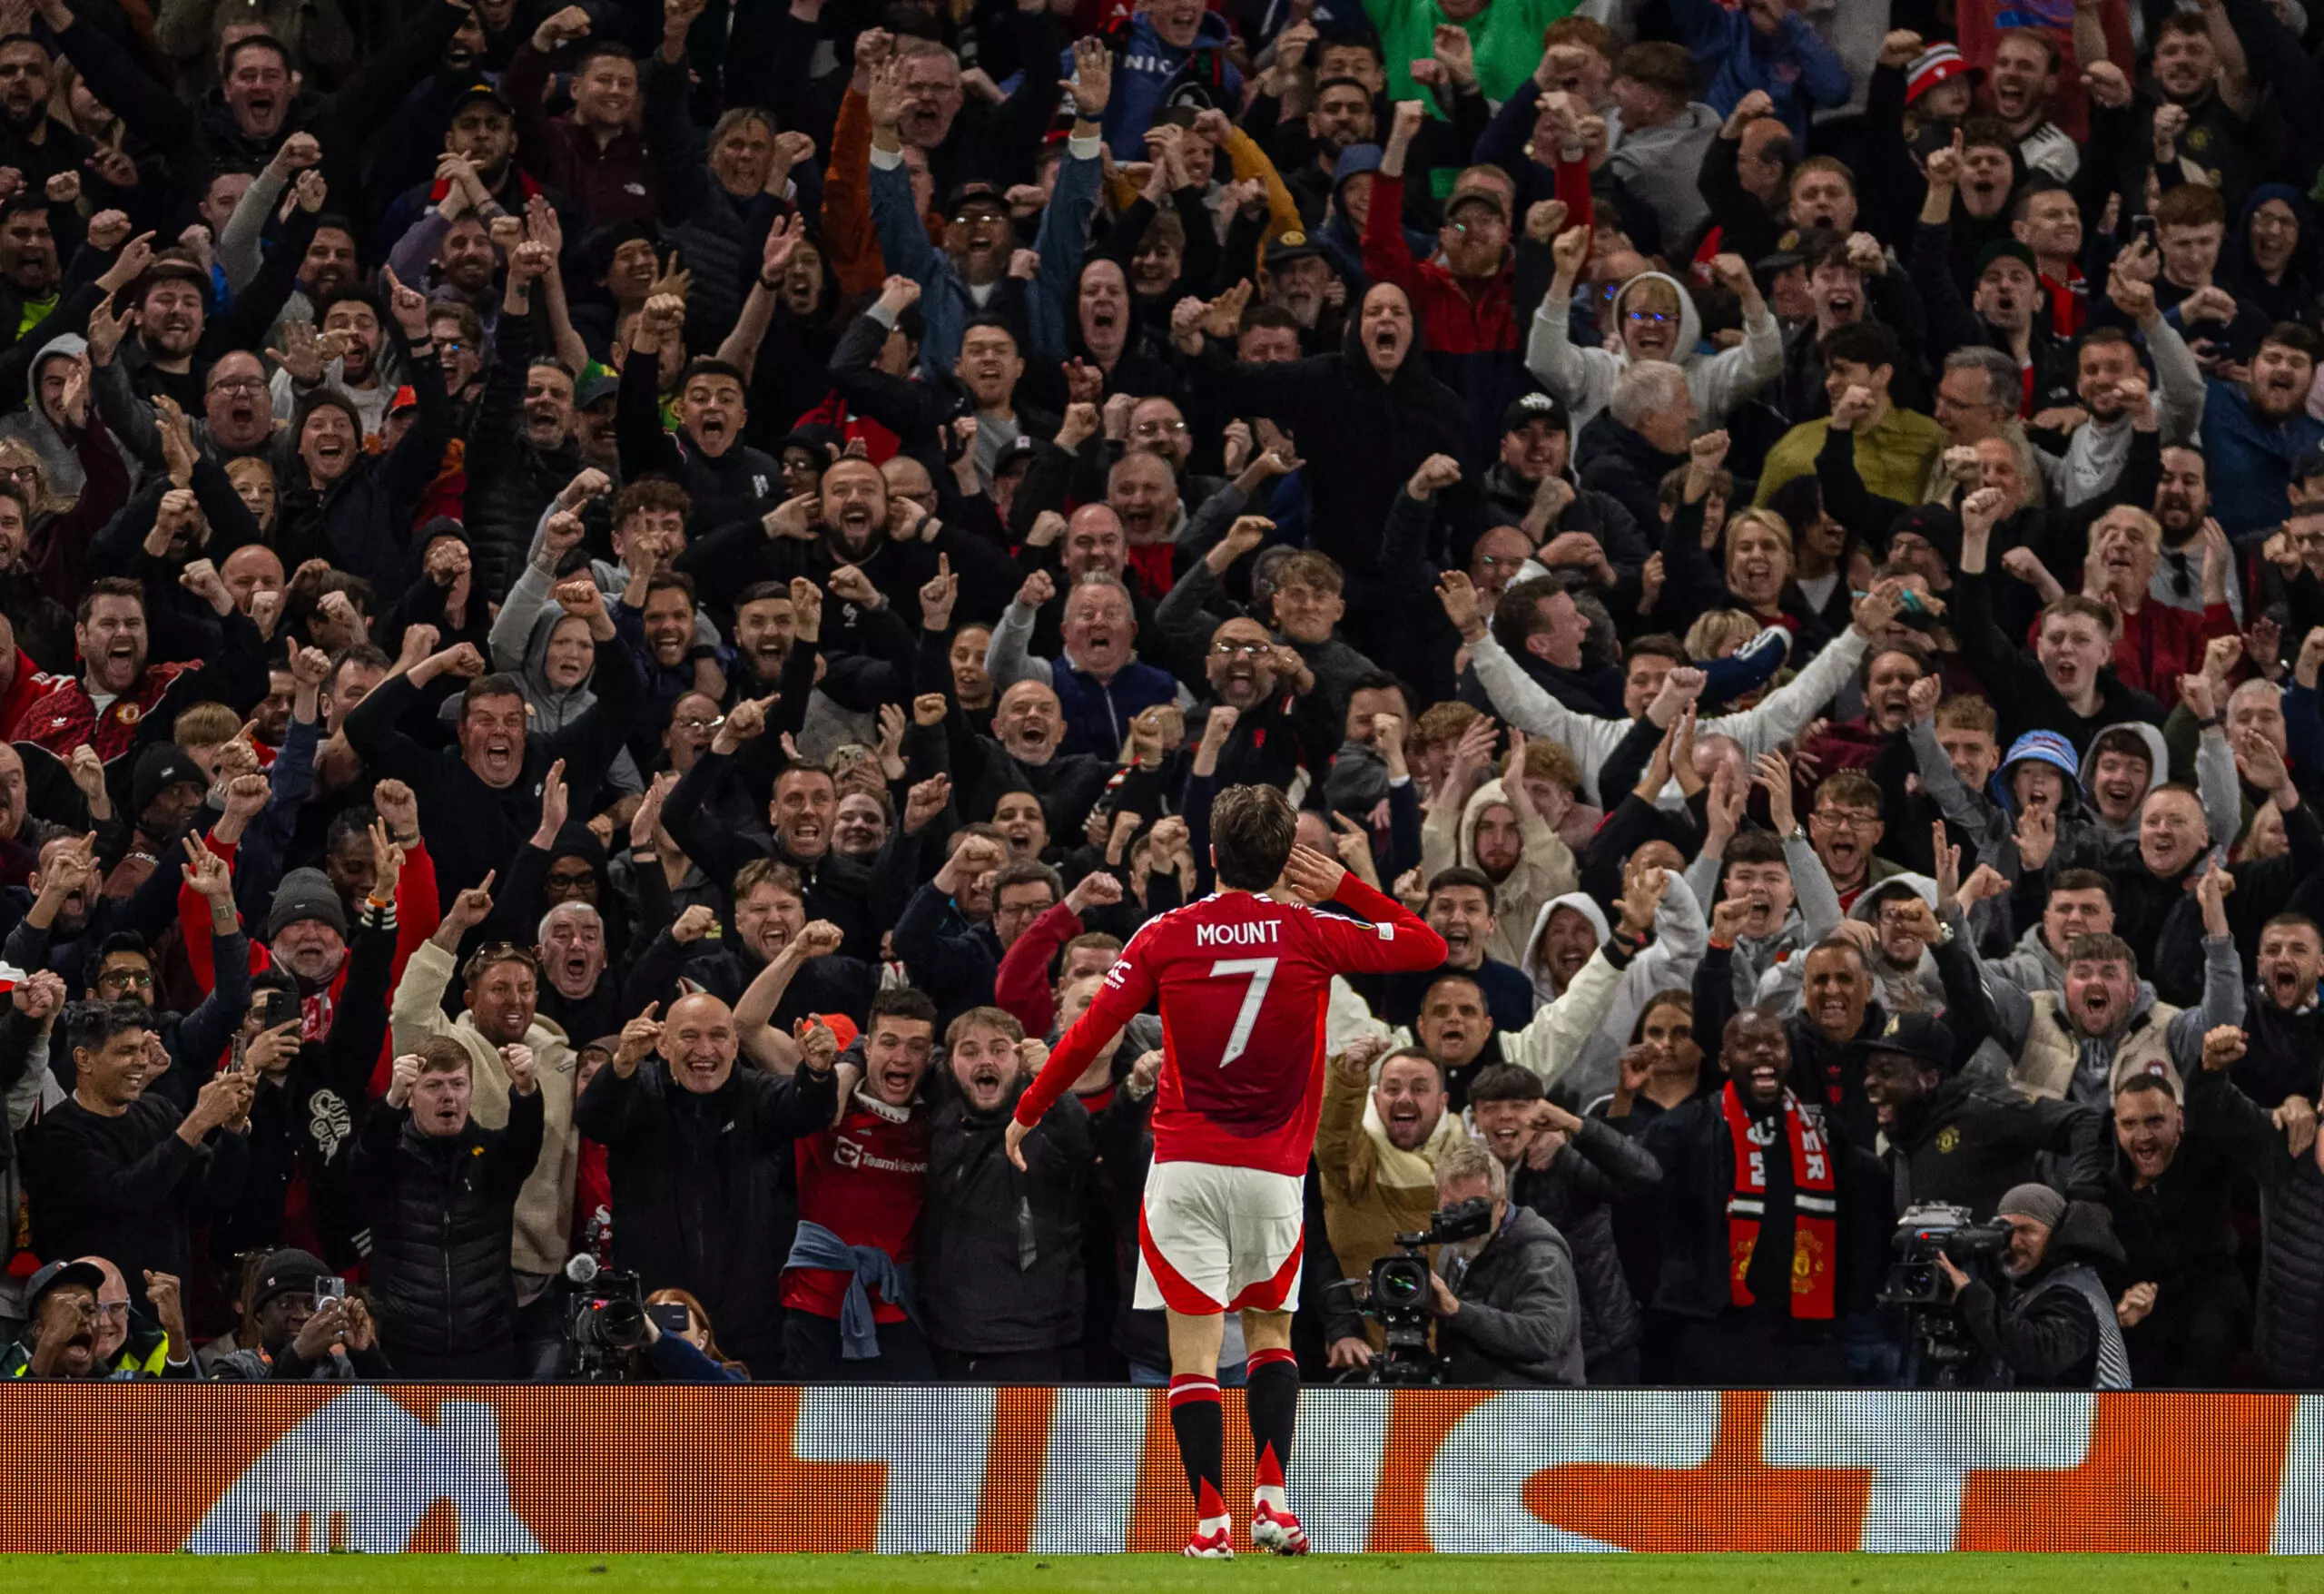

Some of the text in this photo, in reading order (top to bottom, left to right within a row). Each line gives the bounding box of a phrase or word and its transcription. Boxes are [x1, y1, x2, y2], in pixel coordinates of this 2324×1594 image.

[1196, 920, 1282, 947] MOUNT
[1208, 957, 1279, 1069] 7
[862, 1151, 929, 1173] TeamViewe
